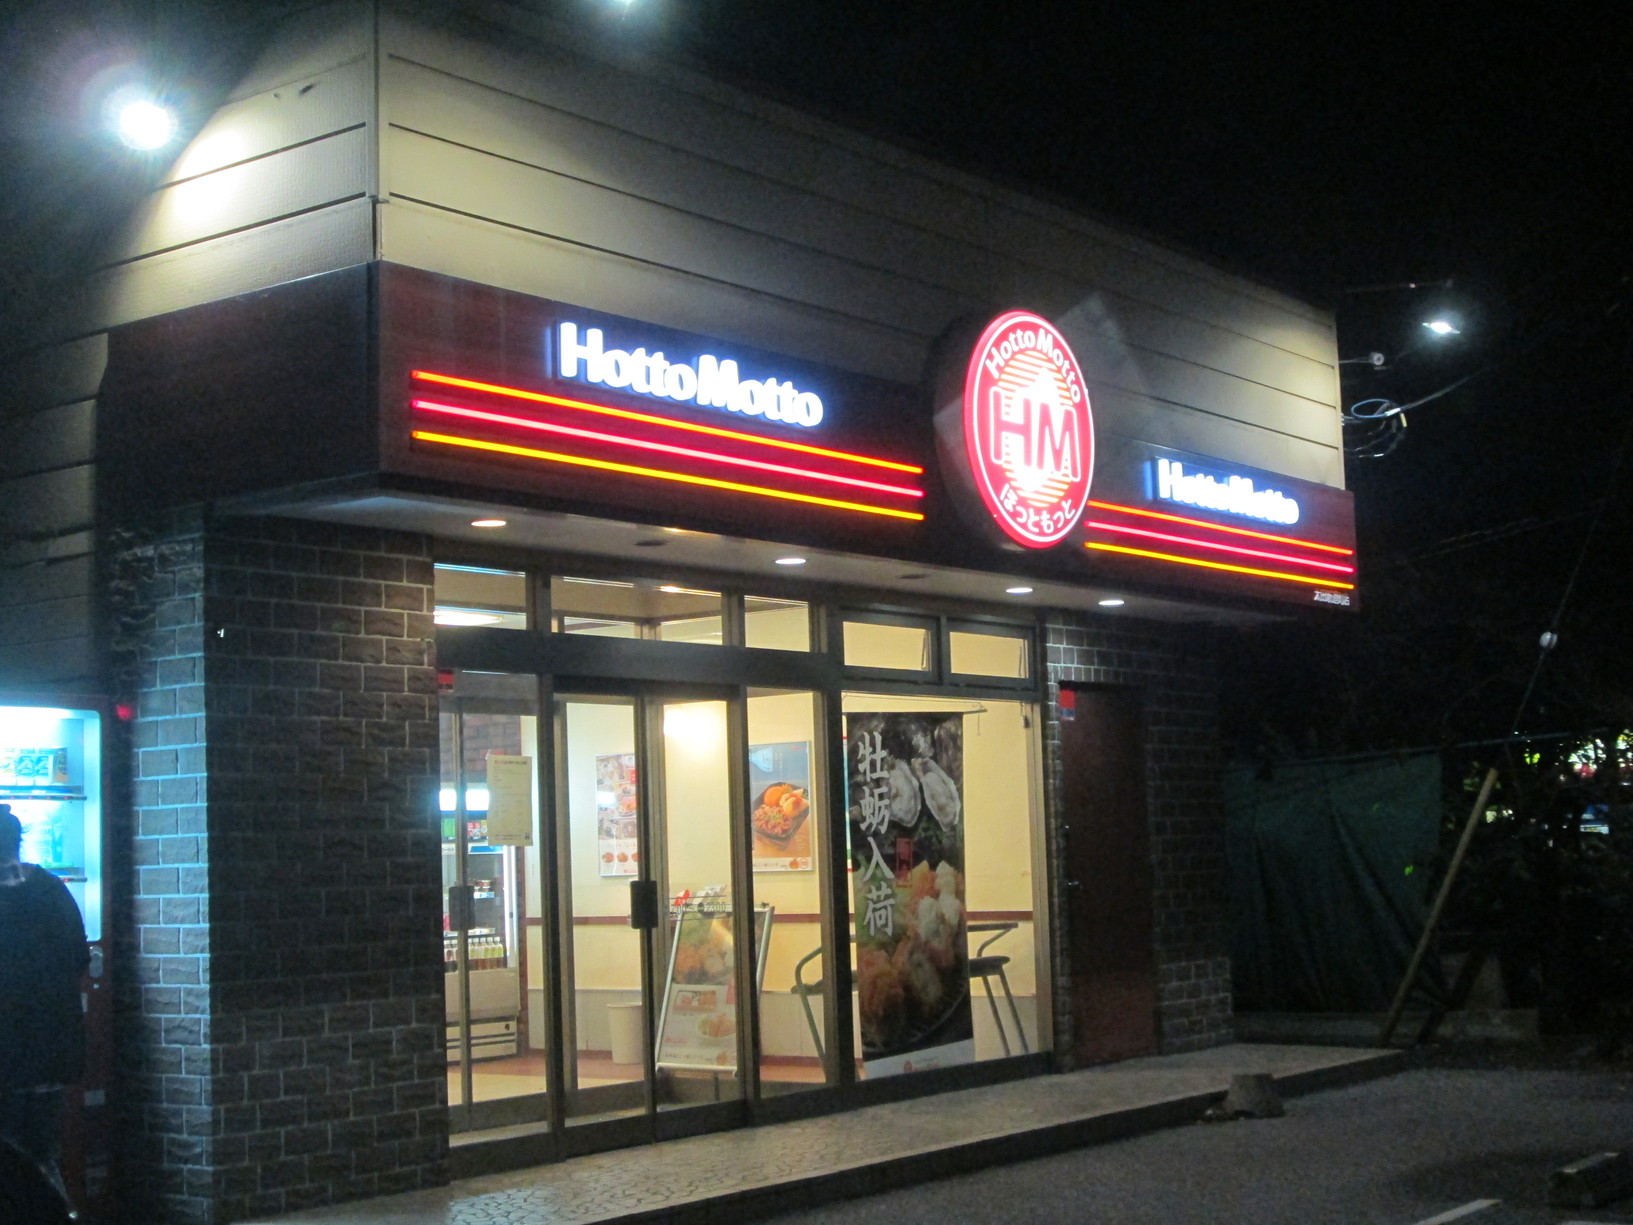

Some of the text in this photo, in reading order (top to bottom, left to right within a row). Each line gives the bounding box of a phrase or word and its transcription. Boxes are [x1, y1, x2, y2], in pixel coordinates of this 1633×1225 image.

[990, 386, 1081, 482] HM
[1000, 483, 1076, 534] ほっともっと
